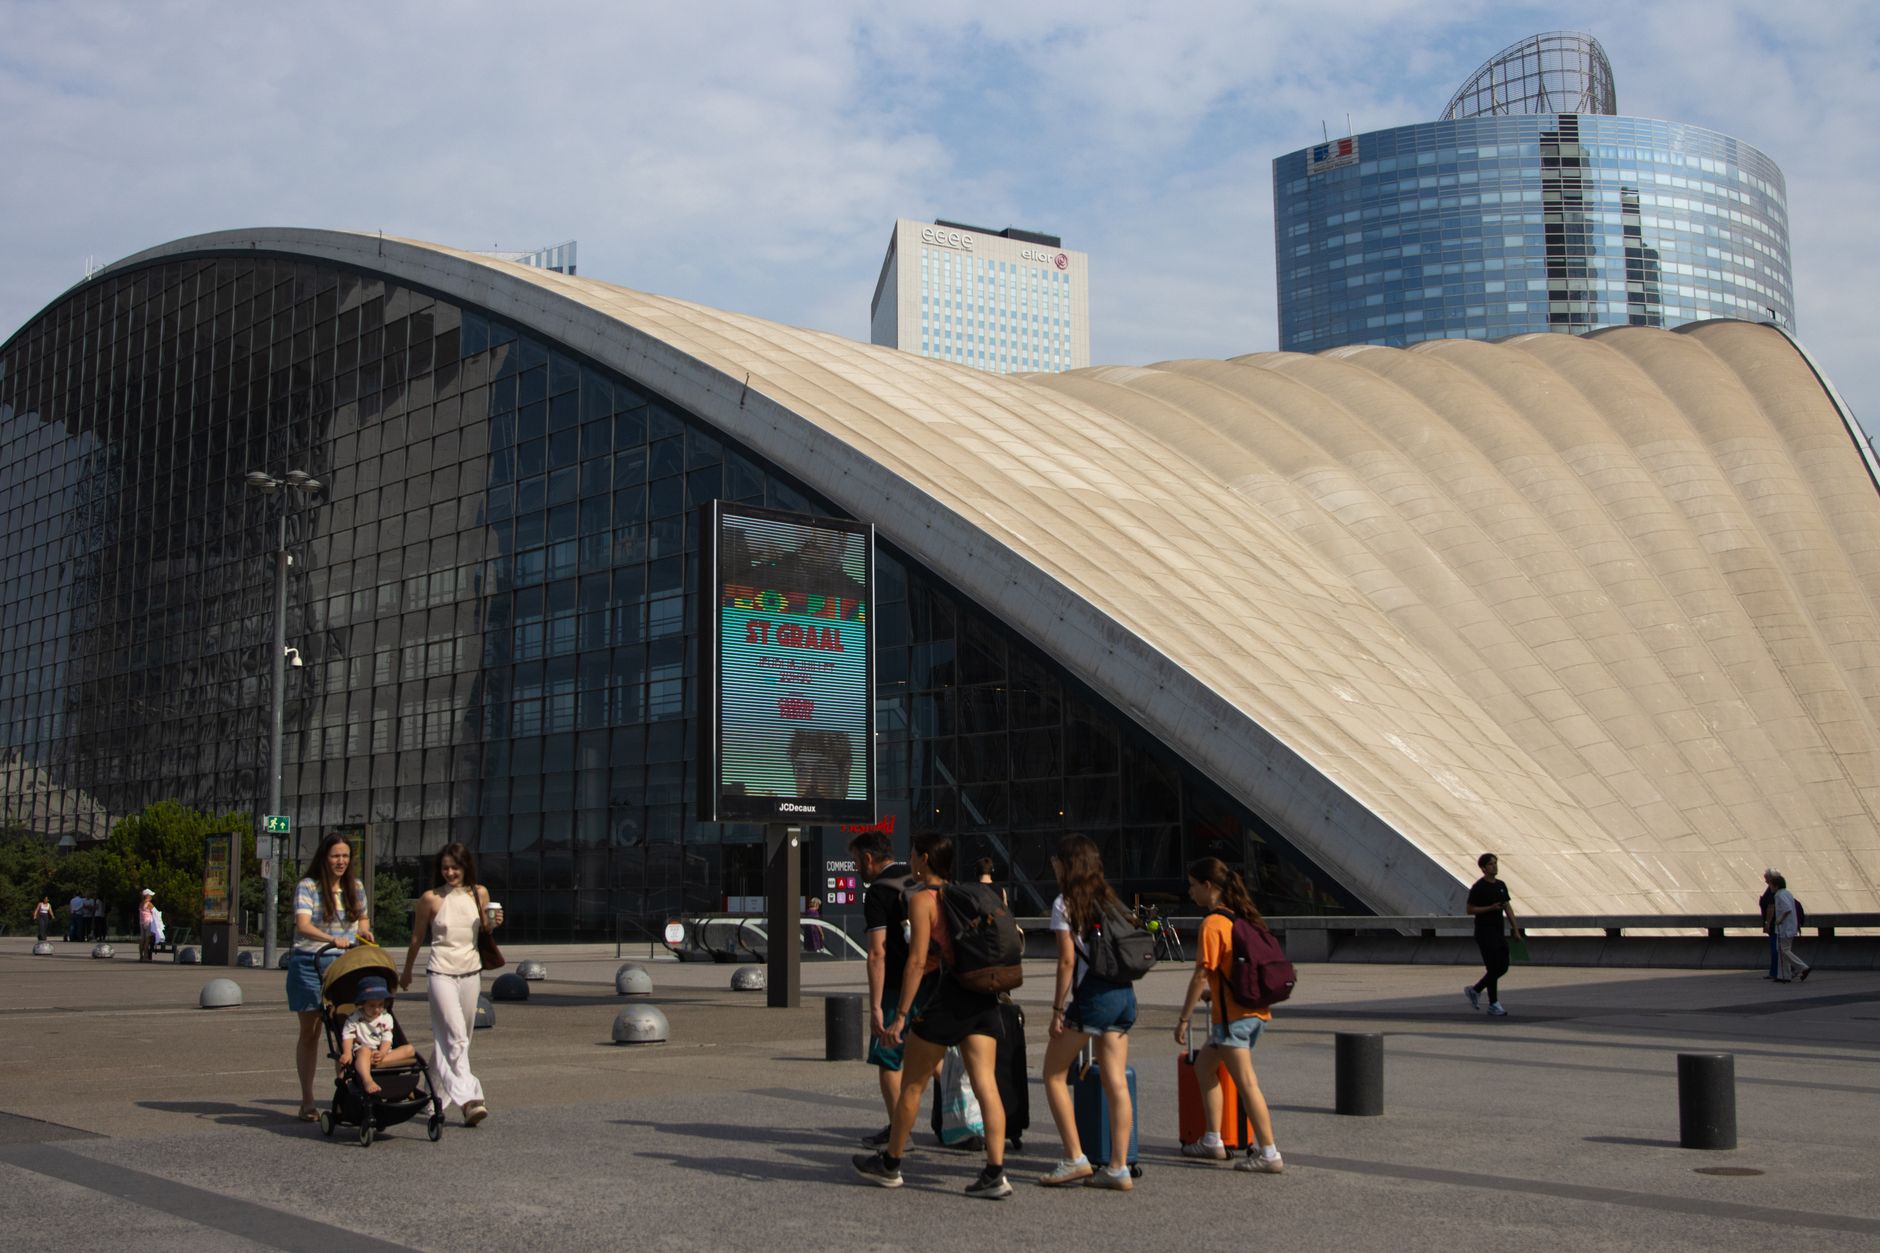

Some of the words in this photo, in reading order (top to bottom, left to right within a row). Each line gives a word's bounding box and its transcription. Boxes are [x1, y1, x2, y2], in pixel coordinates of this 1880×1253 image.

[1021, 249, 1053, 263] elior
[745, 619, 771, 645] ST
[776, 623, 844, 652] GRAAL
[779, 803, 816, 813] JCDecaux
